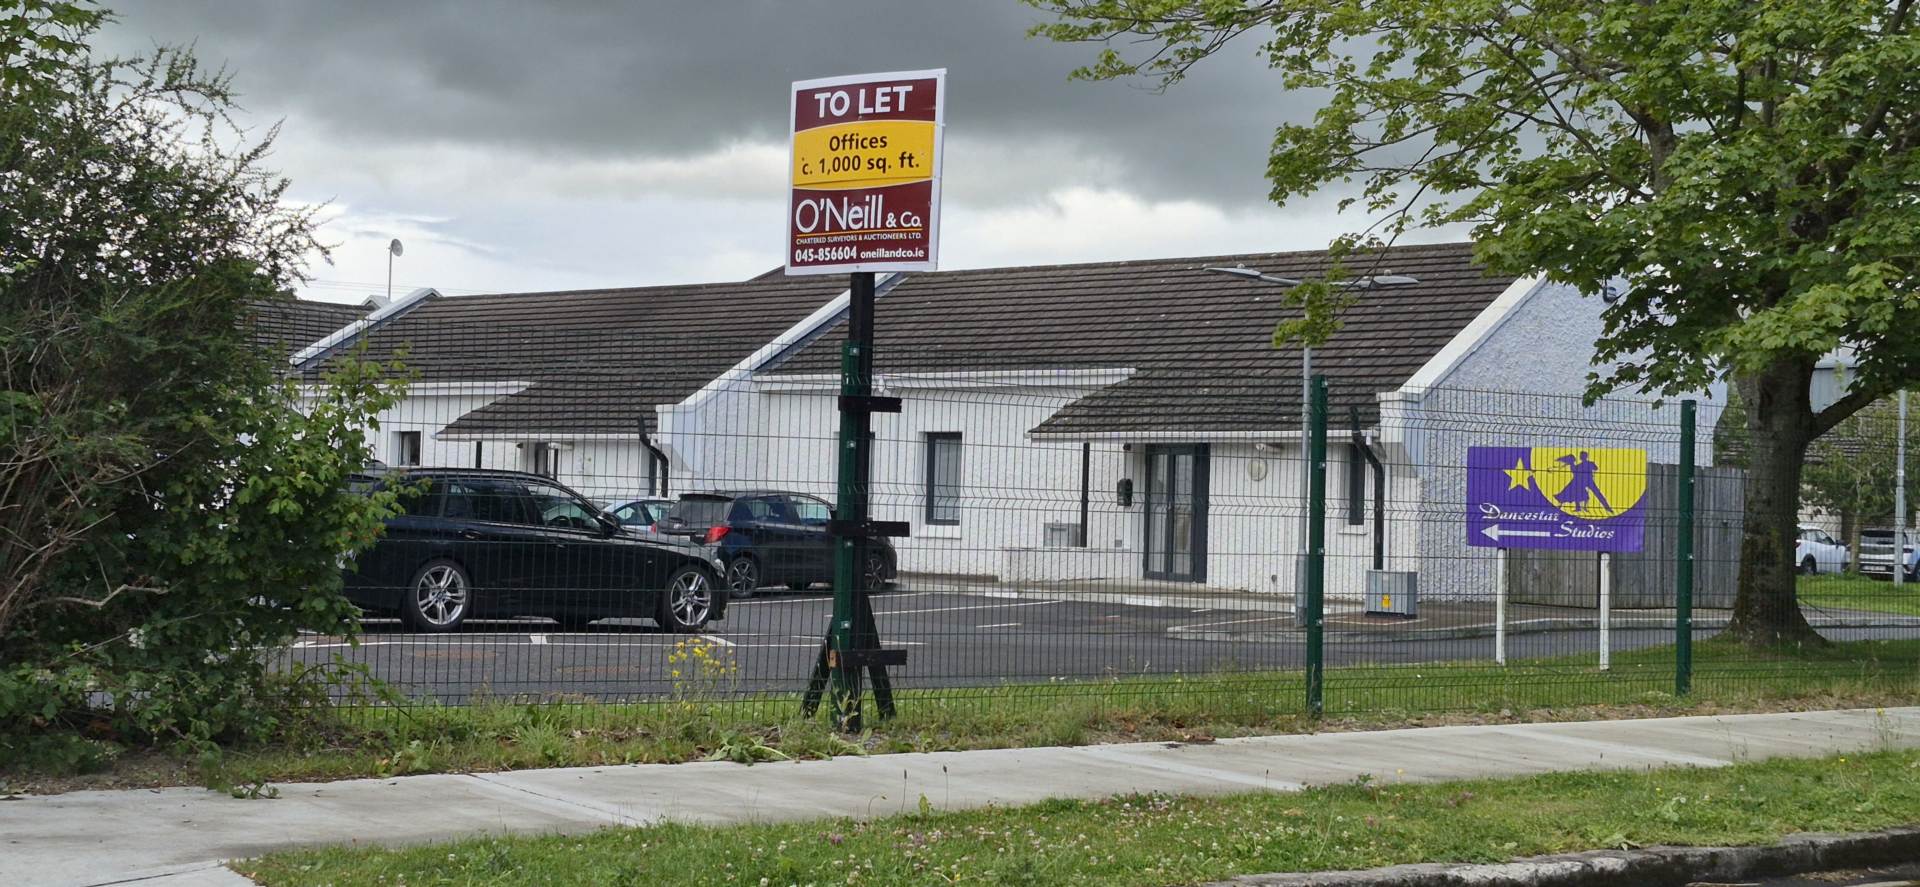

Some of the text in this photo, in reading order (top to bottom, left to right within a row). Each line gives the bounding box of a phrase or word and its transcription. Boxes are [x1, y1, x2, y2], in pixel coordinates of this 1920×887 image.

[814, 85, 913, 118] TO LET
[829, 133, 888, 152] Offices
[802, 152, 920, 175] c. 1,000 sq. ft.
[796, 194, 883, 233] O'Neill
[885, 212, 897, 228] &
[796, 236, 826, 245] CHARTERED
[827, 234, 857, 244] SURVEYORS
[863, 232, 907, 241] AUCTIONEERS
[795, 245, 925, 263] 045-856604 oneillandco.ie
[1479, 502, 1560, 521] Dancestar
[1553, 520, 1615, 539] Studios
